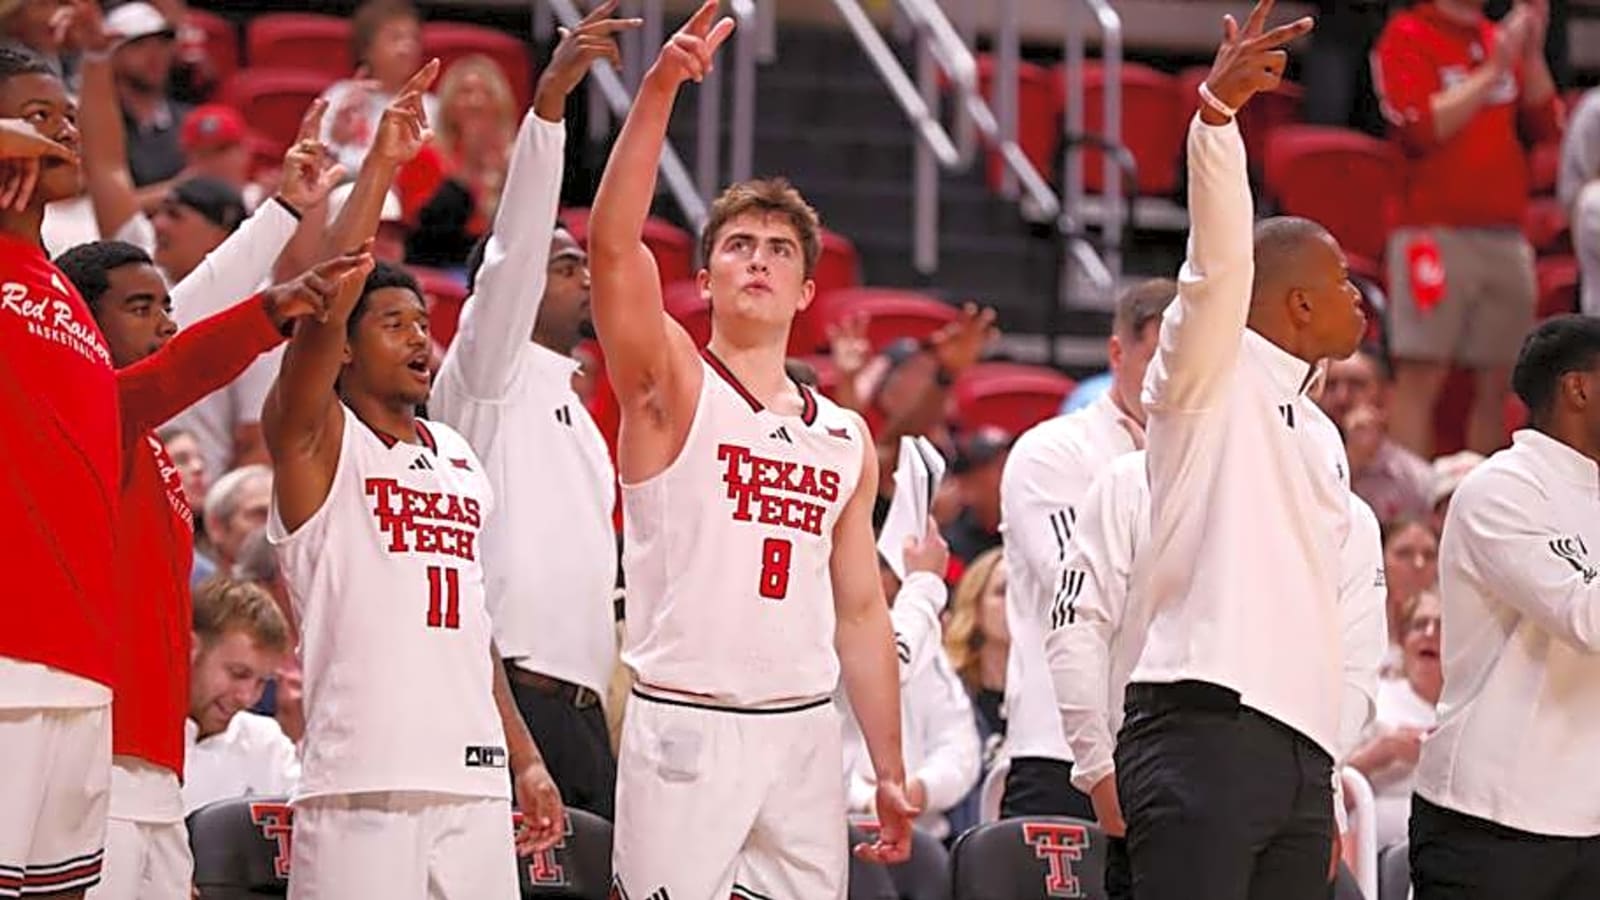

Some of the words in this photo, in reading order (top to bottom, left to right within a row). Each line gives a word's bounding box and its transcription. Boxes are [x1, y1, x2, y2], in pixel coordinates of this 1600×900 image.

[2, 282, 50, 321] Red
[717, 443, 841, 503] TEXAS
[365, 478, 481, 529] TEXAS
[727, 481, 827, 537] TECH
[380, 513, 475, 562] TECH
[759, 537, 792, 600] 8
[427, 565, 460, 629] 11
